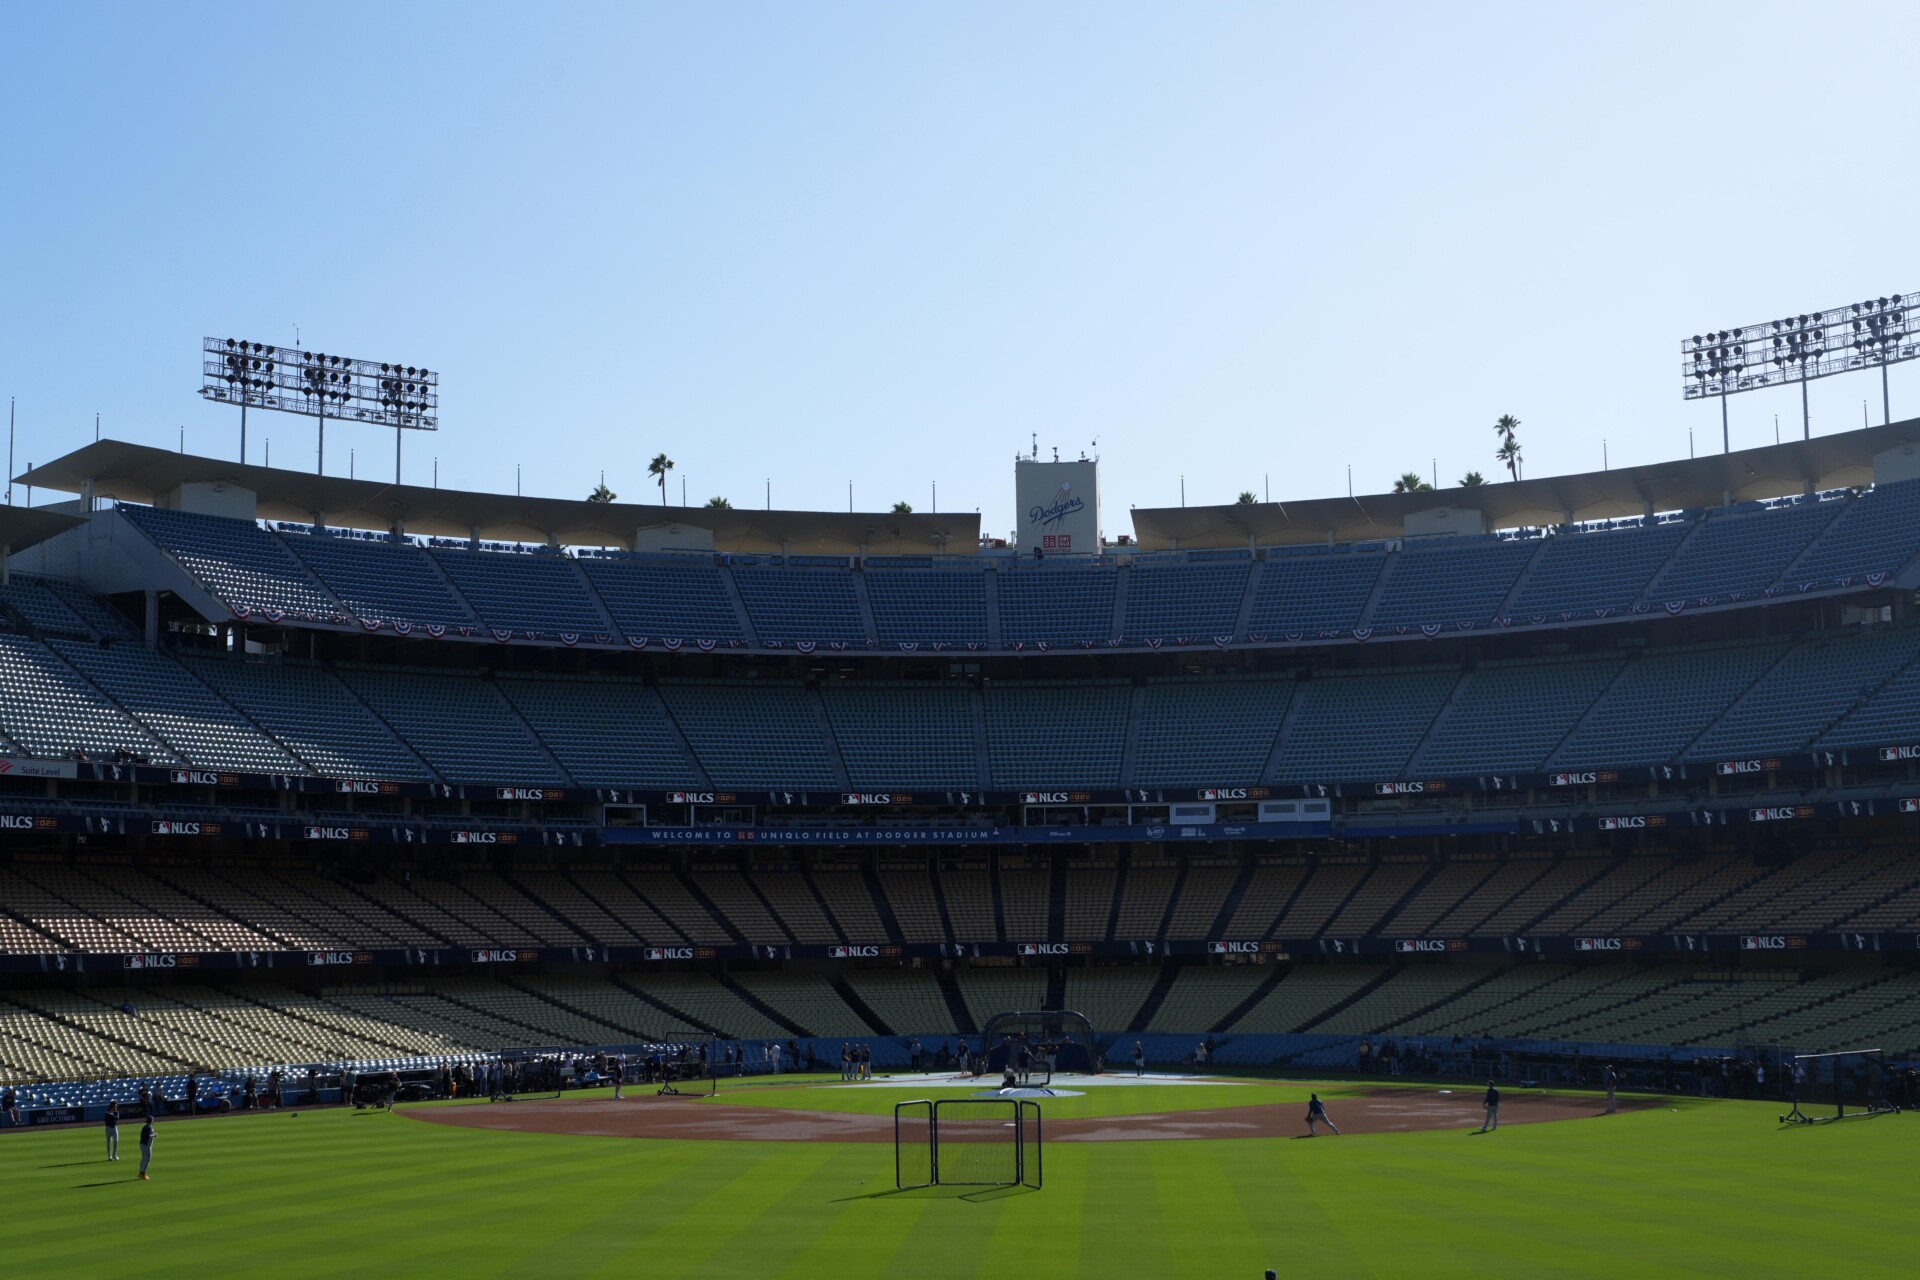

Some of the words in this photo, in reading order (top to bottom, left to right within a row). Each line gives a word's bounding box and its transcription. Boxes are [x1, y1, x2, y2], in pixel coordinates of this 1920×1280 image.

[1030, 497, 1084, 524] Dodgers
[21, 766, 40, 775] Suite
[41, 767, 60, 776] Level
[1735, 760, 1761, 773] NLCS
[190, 772, 217, 784] NLCS
[1569, 772, 1596, 784] NLCS
[353, 782, 379, 793] NLCS
[1395, 781, 1424, 792] NLCS
[515, 789, 542, 800] NLCS
[686, 793, 714, 803] NLCS
[861, 794, 890, 804] NLCS
[1039, 793, 1068, 802] NLCS
[1218, 789, 1246, 799] NLCS
[1766, 807, 1793, 820] NLCS
[0, 815, 33, 828] NLCS
[1617, 816, 1645, 828] NLCS
[171, 822, 200, 834] NLCS
[321, 828, 349, 839] NLCS
[469, 832, 496, 843] NLCS
[652, 831, 710, 839] WELCOME
[717, 831, 731, 839] TO
[761, 832, 810, 840] UNIQLO
[876, 831, 926, 839] DODGER
[932, 831, 988, 839] STADIUM
[1228, 942, 1259, 952] NLCS
[1415, 940, 1445, 951] NLCS
[1593, 938, 1621, 950] NLCS
[1758, 936, 1785, 948] NLCS
[664, 948, 693, 958] NLCS
[849, 946, 879, 956] NLCS
[1038, 944, 1068, 954] NLCS
[145, 954, 175, 968] NLCS
[325, 952, 353, 964] NLCS
[489, 950, 517, 961] NLCS
